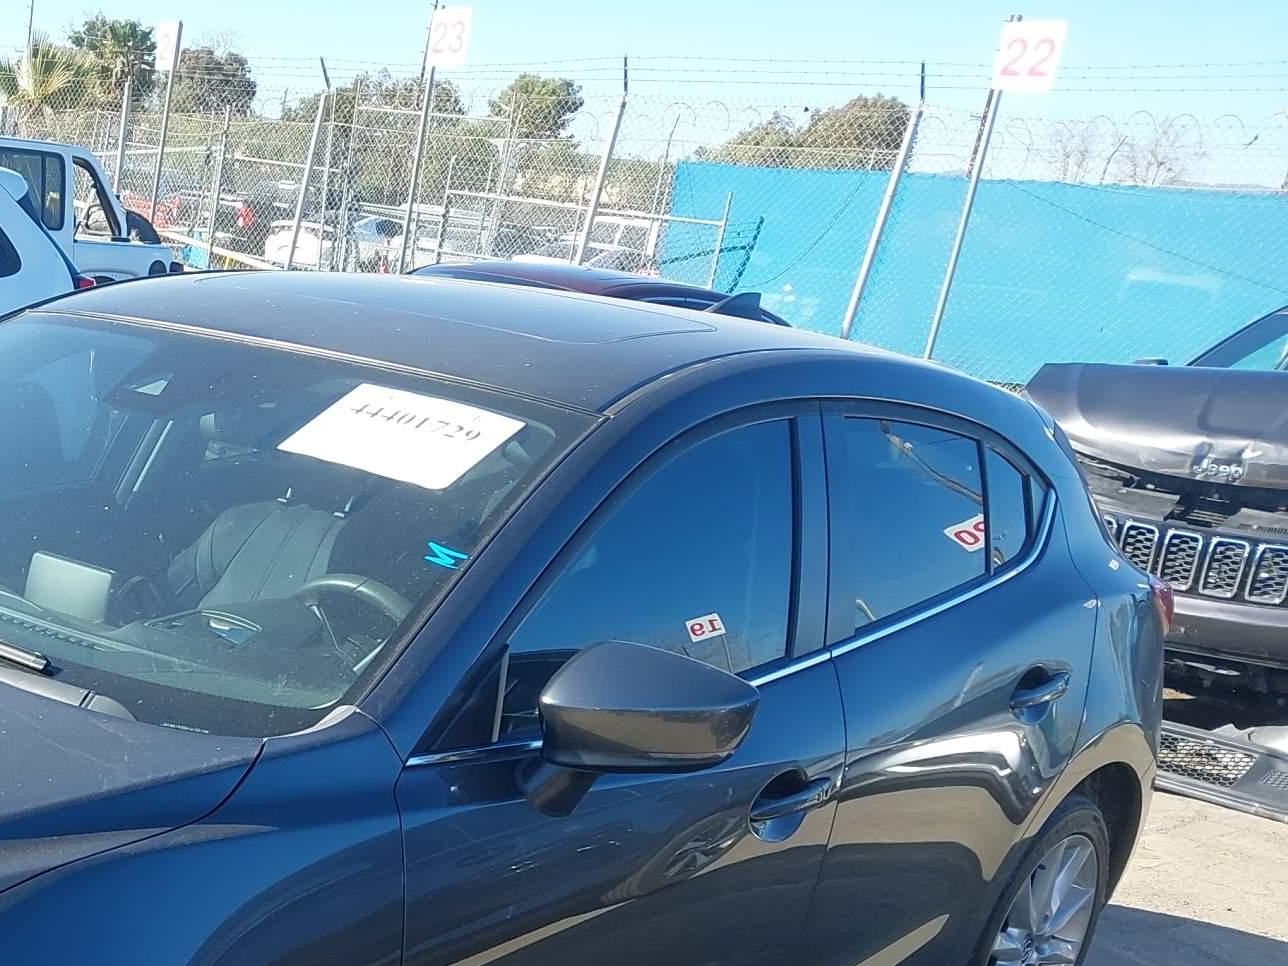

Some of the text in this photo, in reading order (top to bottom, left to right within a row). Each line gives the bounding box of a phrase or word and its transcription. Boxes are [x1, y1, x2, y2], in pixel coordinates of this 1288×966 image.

[431, 21, 464, 53] 23
[999, 37, 1056, 76] 22
[350, 403, 481, 441] 44401729
[1193, 458, 1243, 481] Jeep
